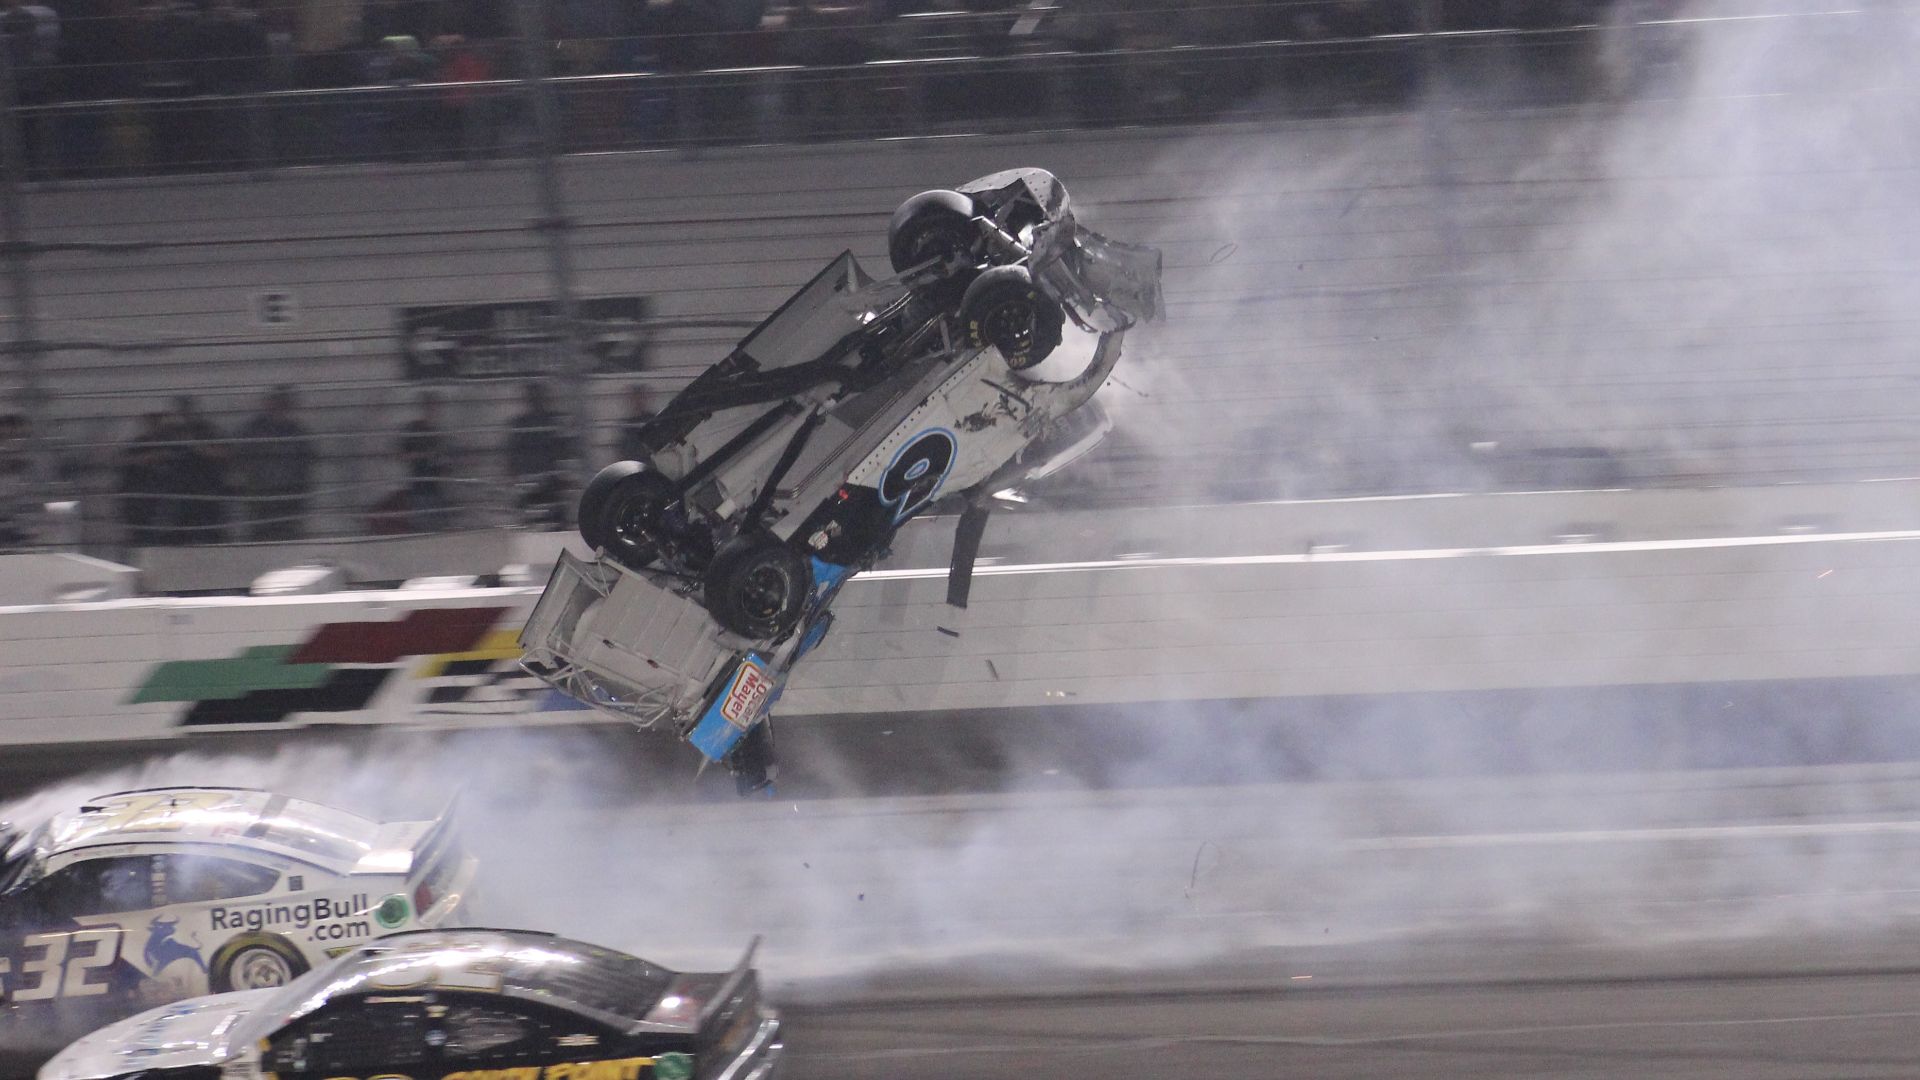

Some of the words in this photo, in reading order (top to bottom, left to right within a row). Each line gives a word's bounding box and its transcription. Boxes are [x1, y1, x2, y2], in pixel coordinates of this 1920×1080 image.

[878, 427, 958, 526] 9
[730, 672, 759, 719] Mayer
[744, 683, 767, 723] Oscar
[211, 893, 368, 931] RagingBull
[308, 920, 370, 942] .com
[12, 926, 123, 1001] 32
